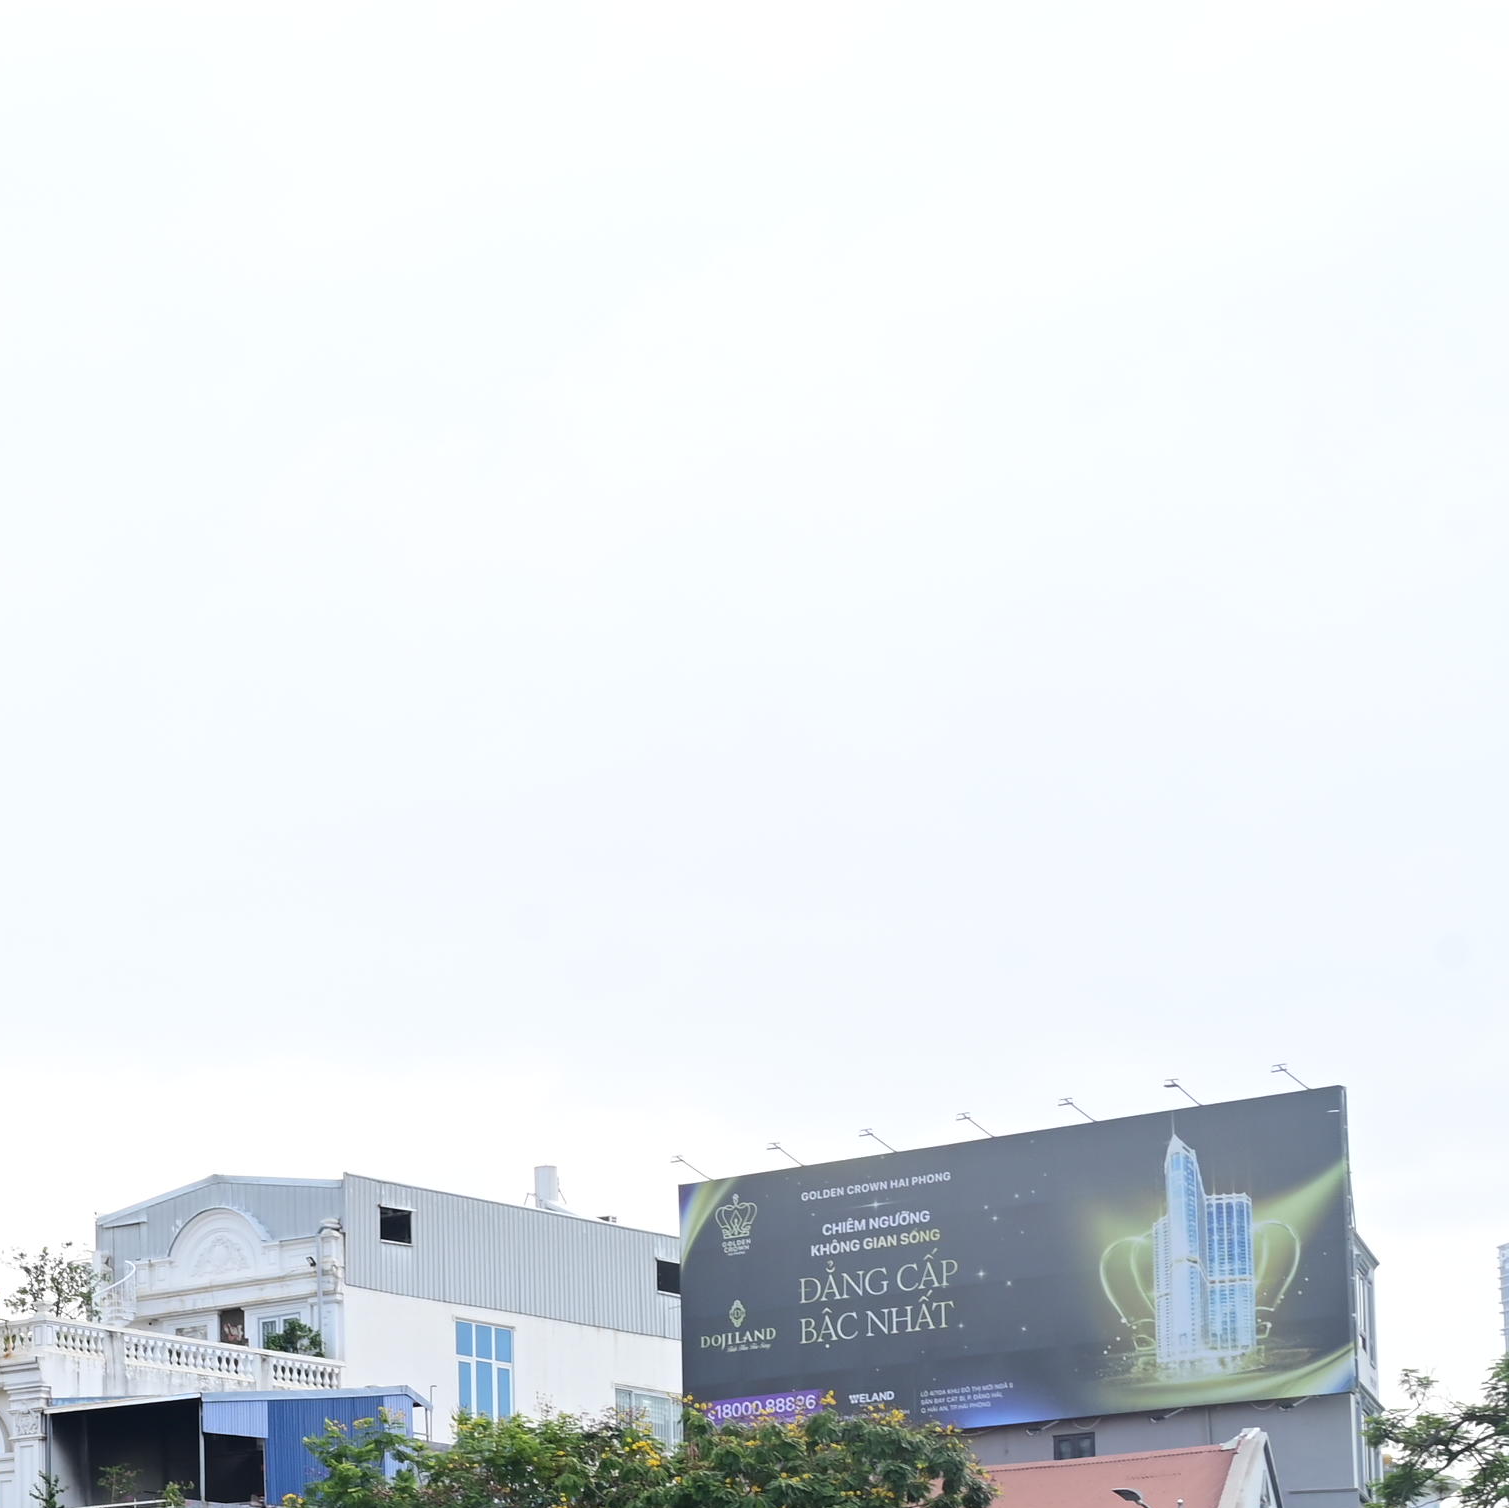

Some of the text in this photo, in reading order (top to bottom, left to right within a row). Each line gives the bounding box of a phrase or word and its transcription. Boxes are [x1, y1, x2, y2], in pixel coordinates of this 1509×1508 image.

[801, 1171, 951, 1202] GOLDEN CROWN HAI PHONG
[822, 1210, 930, 1236] CHIÊM NGƯỠNG
[810, 1227, 940, 1257] KHÔNG GIAN SỐNG
[799, 1248, 958, 1304] ĐẲNG CẤP
[799, 1290, 955, 1349] BẬC NHẤT
[700, 1327, 776, 1351] DOJILAND
[848, 1391, 895, 1405] WELAND
